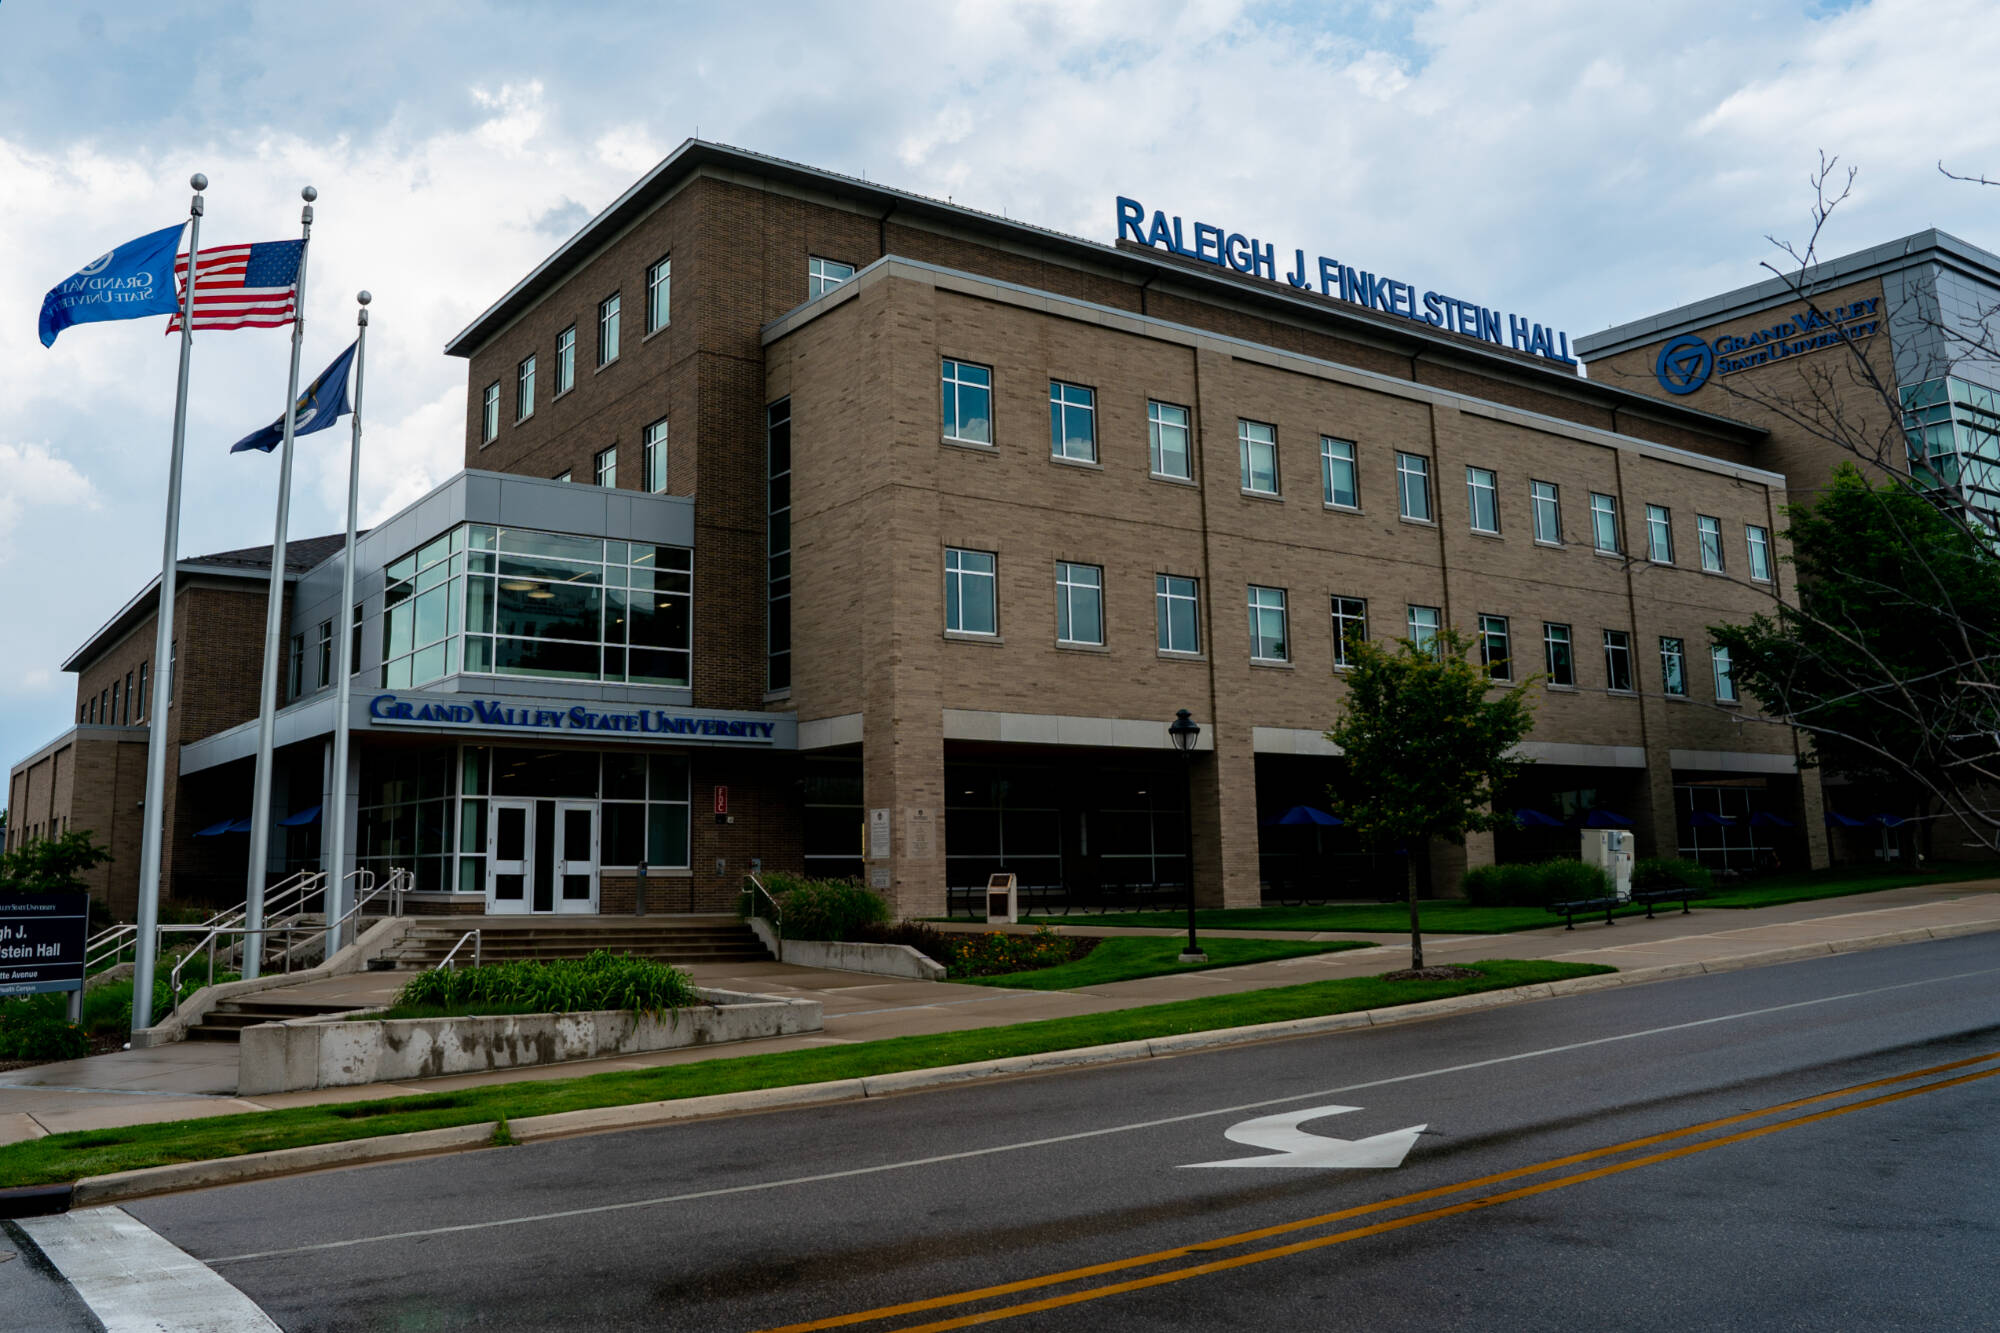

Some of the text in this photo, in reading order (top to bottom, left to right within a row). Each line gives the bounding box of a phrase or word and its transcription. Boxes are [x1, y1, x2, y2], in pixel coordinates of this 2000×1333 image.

[1116, 195, 1578, 365] RALEIGH J. FINKELSTEIN HALL
[1711, 297, 1879, 356] GRAND VALLEY
[1717, 351, 1768, 375] STATE
[370, 694, 775, 738] GRAND VALLEY STATE UNIVERSITY
[15, 925, 27, 939] J.
[0, 942, 61, 959] stein Hall
[11, 970, 38, 979] Avenue
